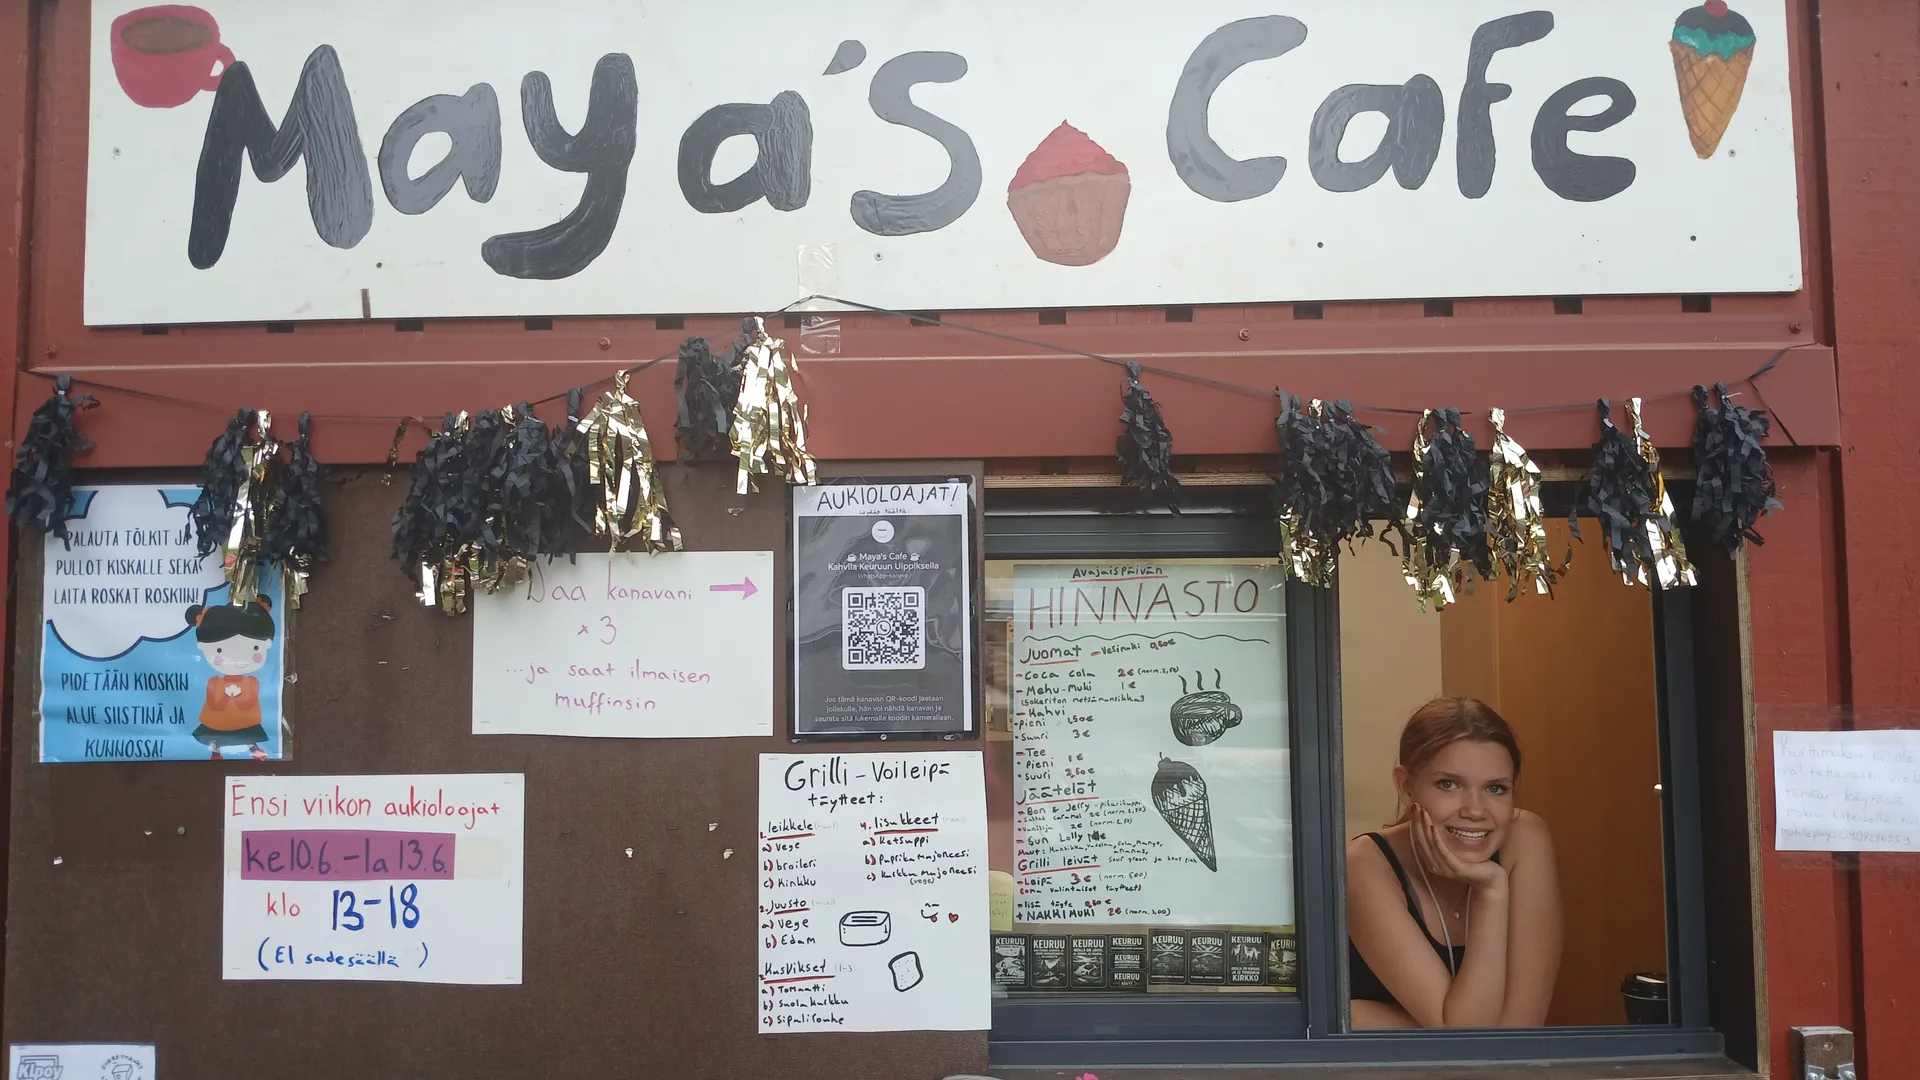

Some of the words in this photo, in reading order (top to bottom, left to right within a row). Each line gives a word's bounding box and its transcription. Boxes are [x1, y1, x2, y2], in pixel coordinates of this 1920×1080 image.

[1167, 11, 1636, 202] Cafe
[816, 485, 959, 512] AUKIOLOAJAT!
[125, 528, 170, 546] TÖLKIT
[859, 552, 887, 562] Maya's
[889, 552, 908, 560] Cafe
[55, 559, 103, 576] PULLOT
[107, 558, 164, 576] KISKALLE
[828, 562, 857, 571] Kahvila
[859, 562, 893, 571] Keuruun
[607, 560, 692, 601] kanavani
[54, 588, 88, 605] LAITA
[91, 588, 140, 604] ROSKAT
[145, 587, 199, 604] ROSKIIN!
[1030, 578, 1259, 631] HINNASTO
[600, 616, 617, 645] 3
[568, 661, 615, 678] saat
[629, 658, 711, 684] ilmaisen
[61, 669, 129, 691] PIDETÄÄN
[134, 672, 189, 691] KIOSKIN
[555, 692, 656, 716] muffinsin
[918, 695, 944, 703] jaetaan
[66, 705, 100, 725] ALUE
[103, 703, 164, 725] SIISTINÄ
[169, 706, 185, 725] JA
[85, 739, 164, 758] KUNNOSSA!
[1025, 748, 1046, 757] Tee
[785, 756, 847, 791] Grilli
[231, 784, 288, 817] Ensi
[303, 785, 372, 817] viikon
[384, 785, 500, 830] aukioloajat
[768, 818, 813, 833] leikkele
[776, 858, 816, 870] broileri
[1018, 857, 1049, 871] Grilli
[267, 892, 301, 918] klo
[332, 883, 421, 931] 13-18
[781, 934, 816, 945] Edam
[995, 937, 1025, 945] KEURUU
[1033, 940, 1065, 949] KEURUU
[1073, 939, 1104, 948] KEURUU
[1113, 937, 1142, 945] KEURUU
[1152, 935, 1184, 945] KEURUU
[1192, 937, 1223, 946] KEURUU
[1271, 939, 1296, 951] KEURU
[1232, 974, 1259, 982] KIRKKO
